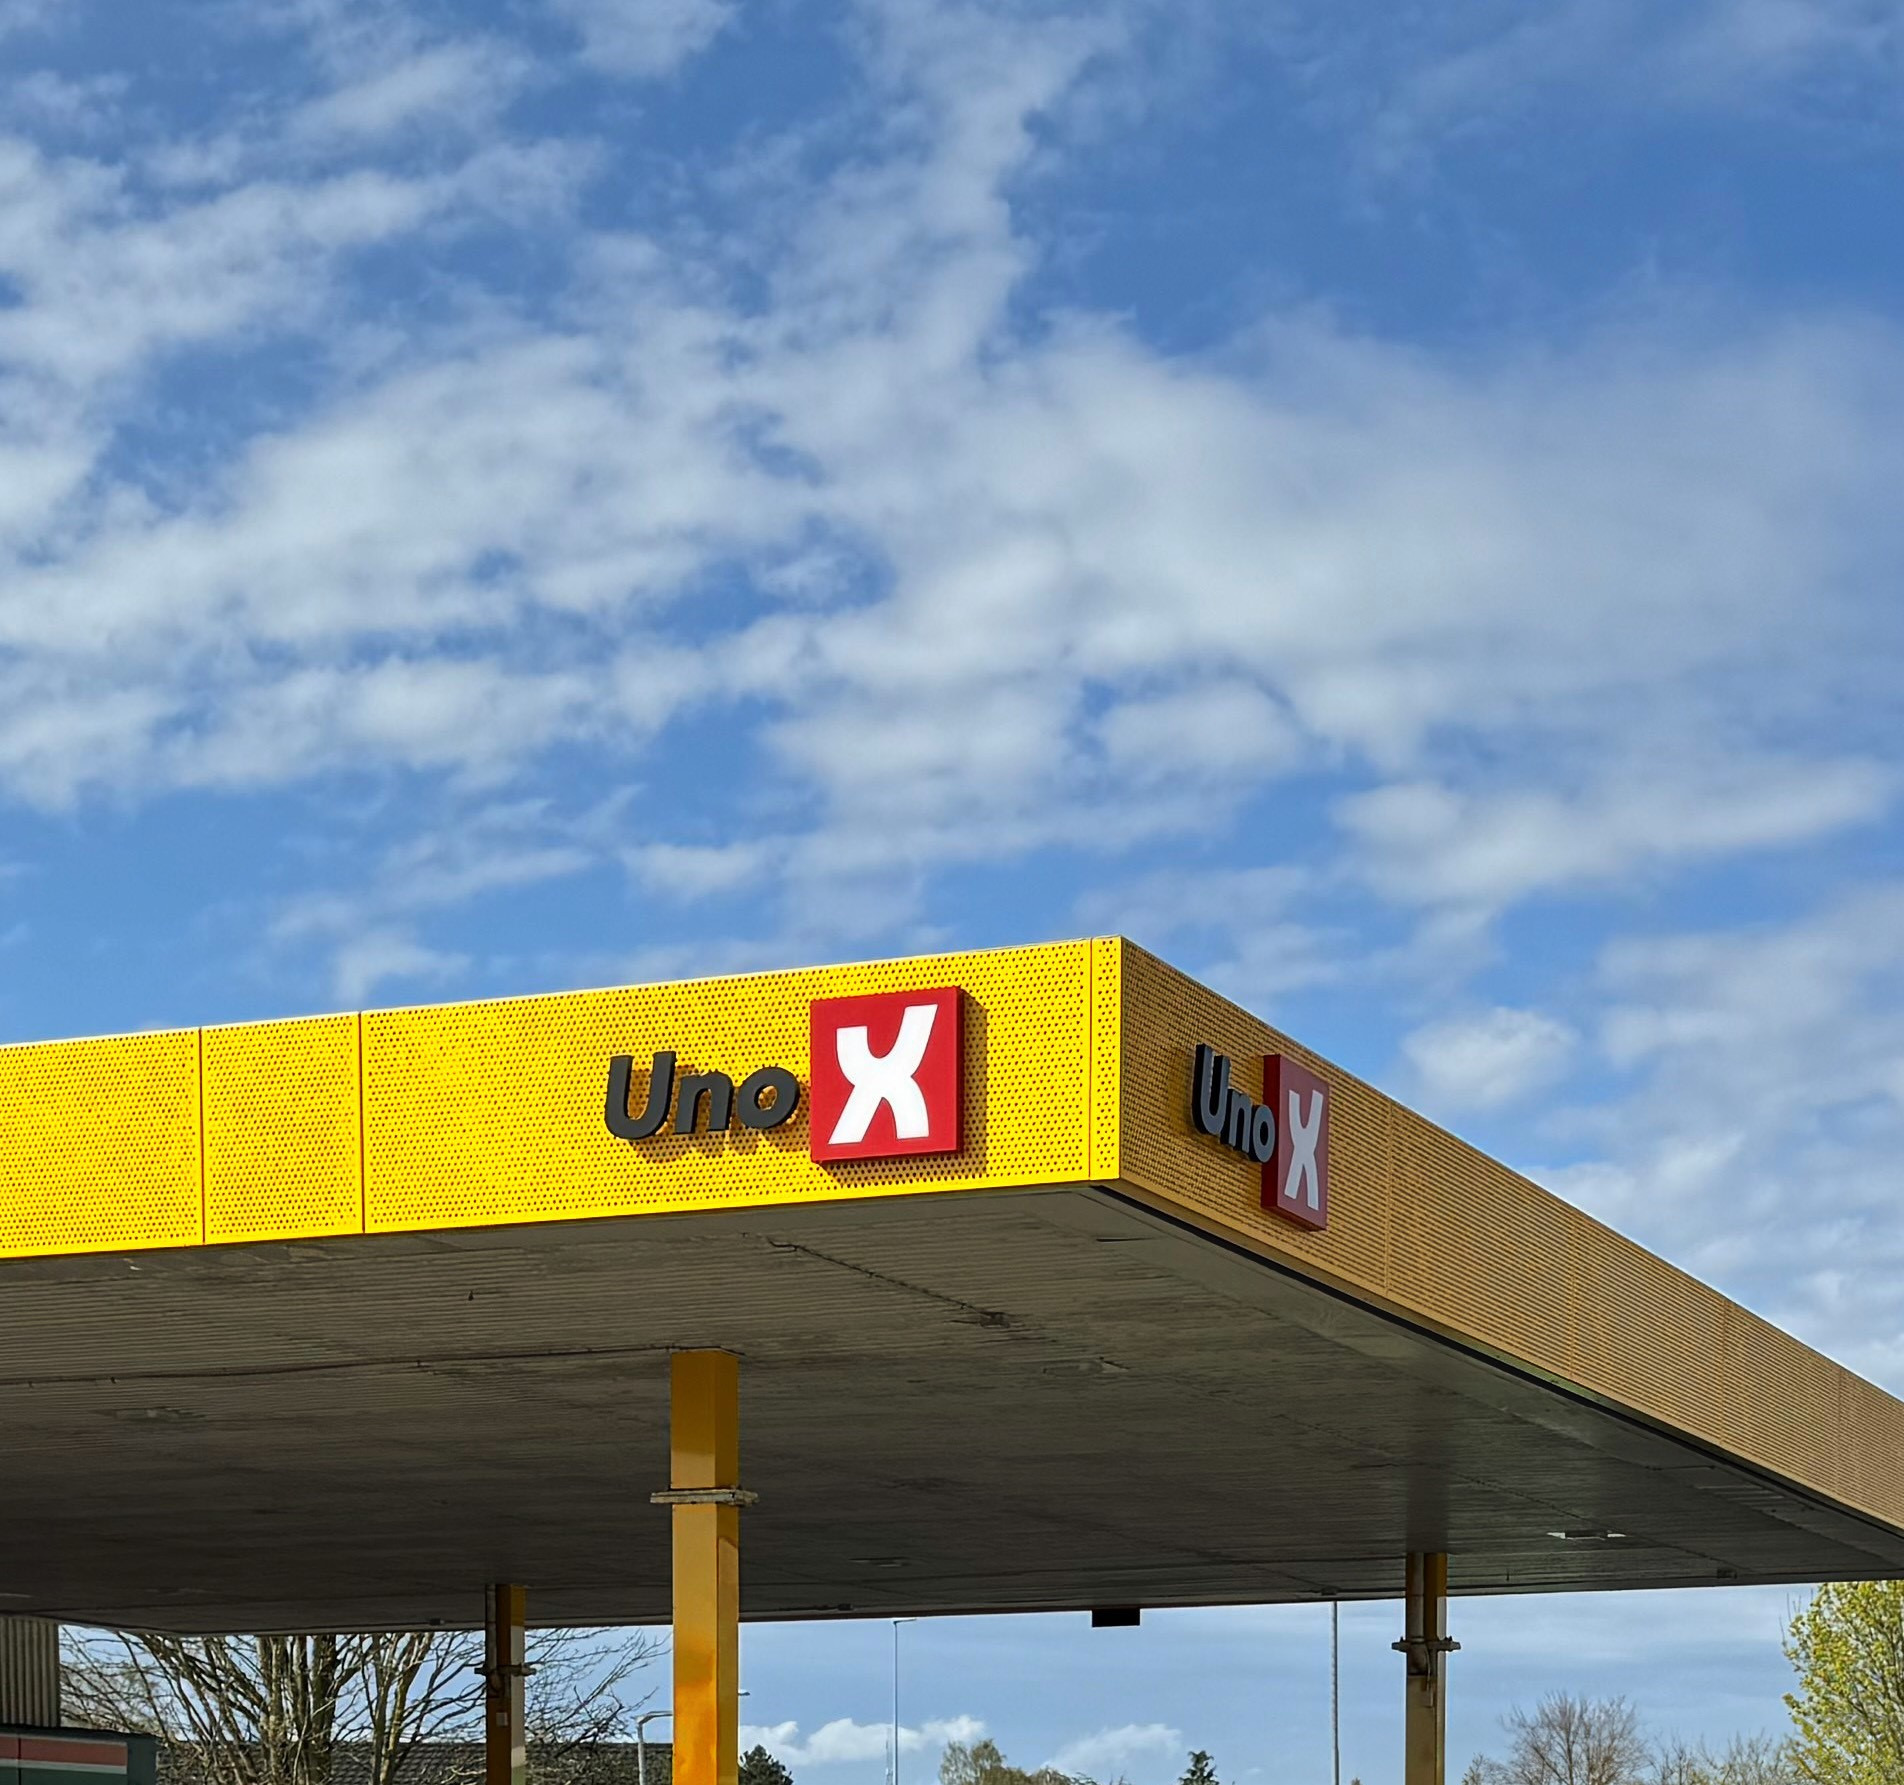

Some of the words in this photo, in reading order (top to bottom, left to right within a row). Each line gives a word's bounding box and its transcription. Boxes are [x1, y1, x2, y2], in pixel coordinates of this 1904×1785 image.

[603, 1051, 797, 1140] Uno
[828, 1004, 938, 1145] X
[1194, 1044, 1277, 1163] Uno
[1283, 1090, 1325, 1211] X
